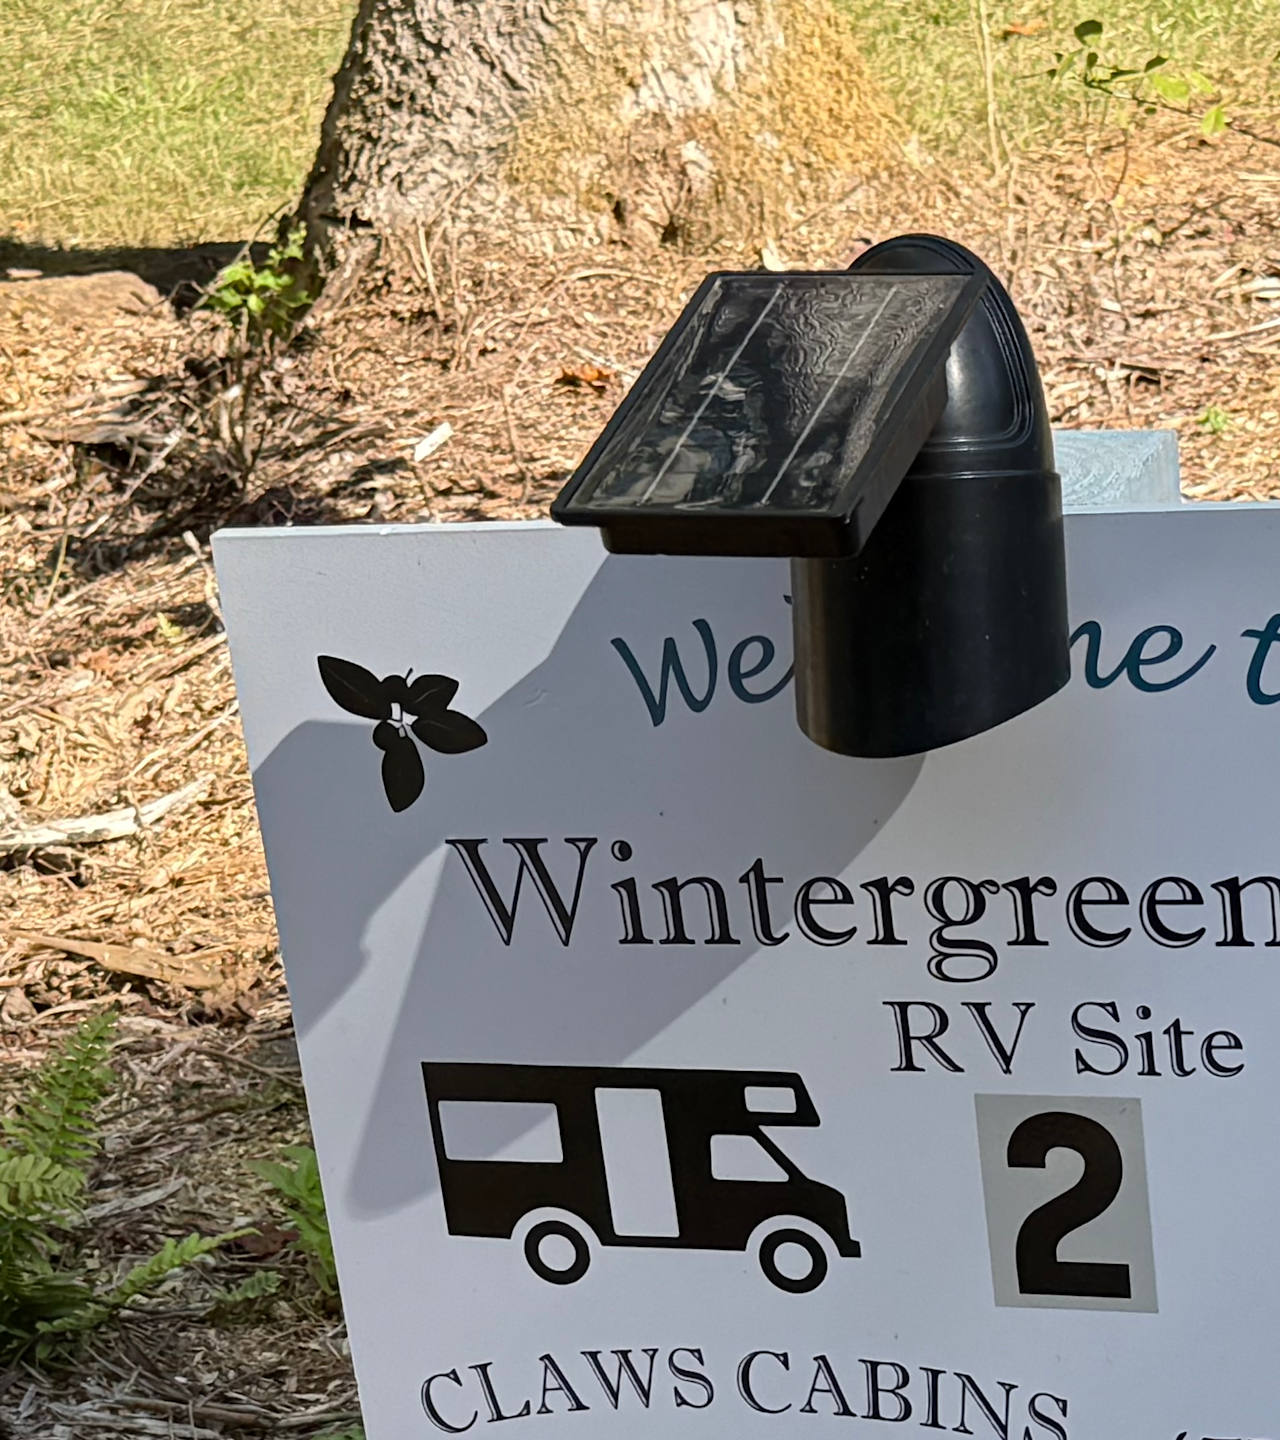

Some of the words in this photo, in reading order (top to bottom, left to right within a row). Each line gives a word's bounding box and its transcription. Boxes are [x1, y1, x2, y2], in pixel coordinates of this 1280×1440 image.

[881, 1000, 1036, 1075] RV
[1070, 1000, 1246, 1078] Site
[1007, 1111, 1131, 1298] 2
[420, 1347, 715, 1435] CLAWS
